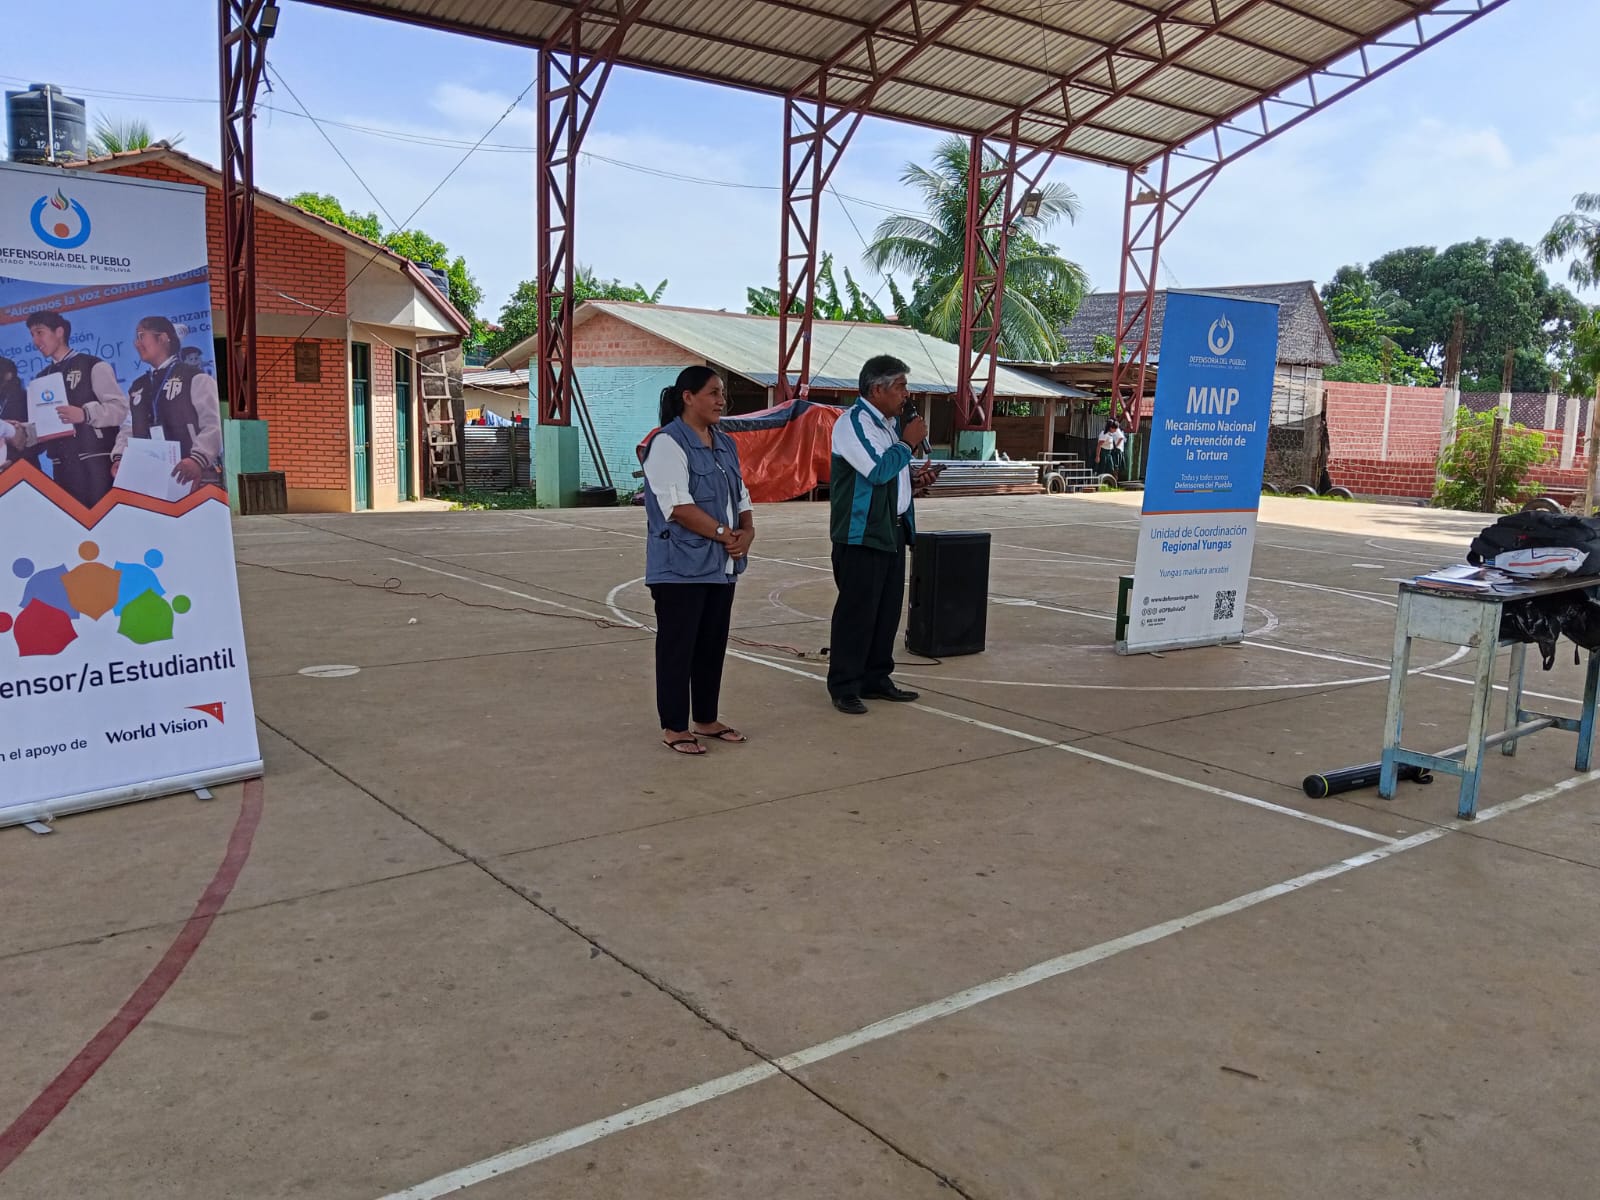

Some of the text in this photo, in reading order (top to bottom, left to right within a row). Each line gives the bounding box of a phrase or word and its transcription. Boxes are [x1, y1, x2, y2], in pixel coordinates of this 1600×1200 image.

[29, 260, 86, 270] PLURINACIONAL
[67, 253, 88, 264] DEL
[90, 255, 131, 267] PUEBLO
[64, 296, 75, 306] la
[79, 291, 100, 301] voz
[103, 281, 147, 297] contra
[1186, 386, 1240, 415] MNP
[1165, 419, 1256, 432] Mecanismo Nacional
[1170, 434, 1246, 447] de Prevención de
[1186, 449, 1228, 461] la Tortura
[1174, 480, 1233, 489] Defensores del Pueblo
[1151, 524, 1247, 540] Unidad de Coordinación
[1162, 540, 1232, 554] Regional Yungas
[1160, 568, 1182, 578] Yungas
[0, 648, 235, 699] ensor/a Estudiantil
[105, 717, 208, 744] World Vision
[9, 749, 21, 761] el
[25, 743, 67, 760] apoyo
[70, 738, 87, 750] de
